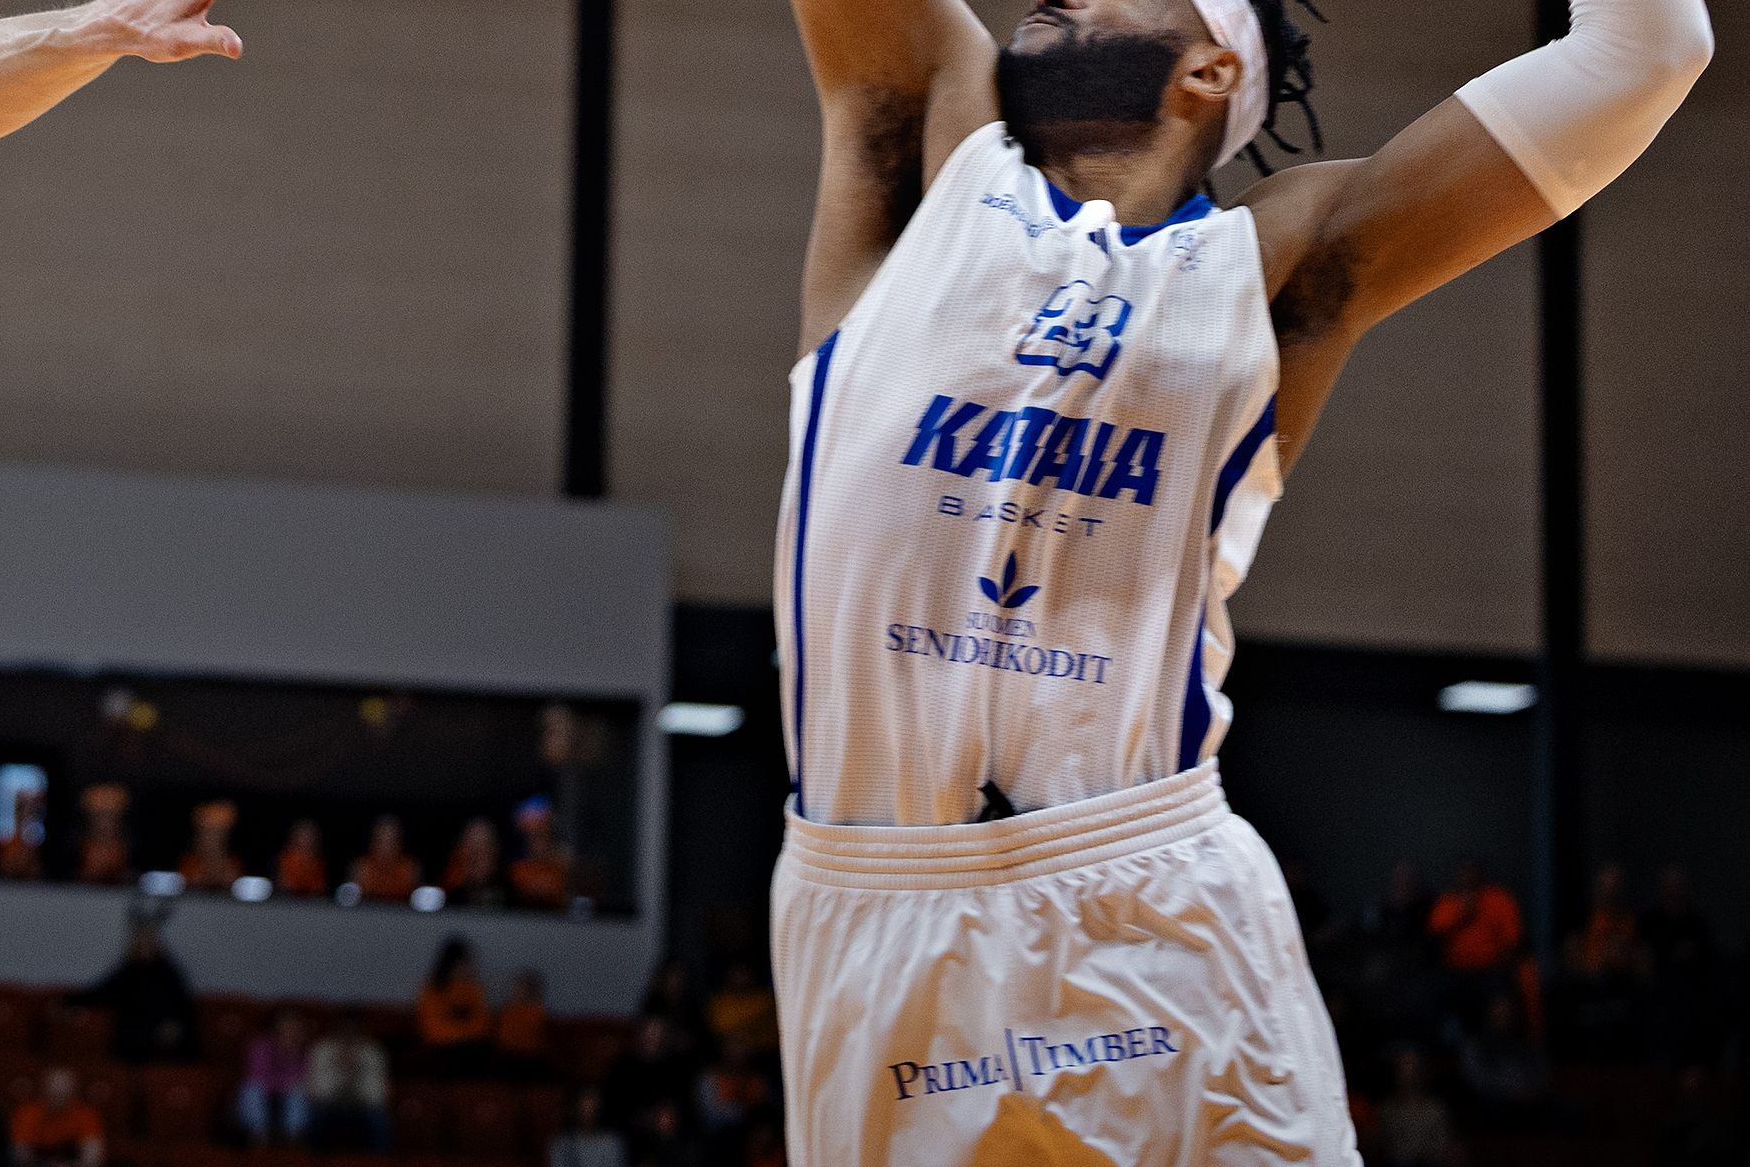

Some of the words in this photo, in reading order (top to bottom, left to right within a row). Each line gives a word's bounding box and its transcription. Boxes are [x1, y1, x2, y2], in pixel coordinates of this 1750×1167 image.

[1015, 279, 1133, 380] 23
[937, 495, 1105, 537] BASKET
[888, 1053, 1010, 1101] PRIMA
[1019, 1025, 1180, 1077] TIMBER
